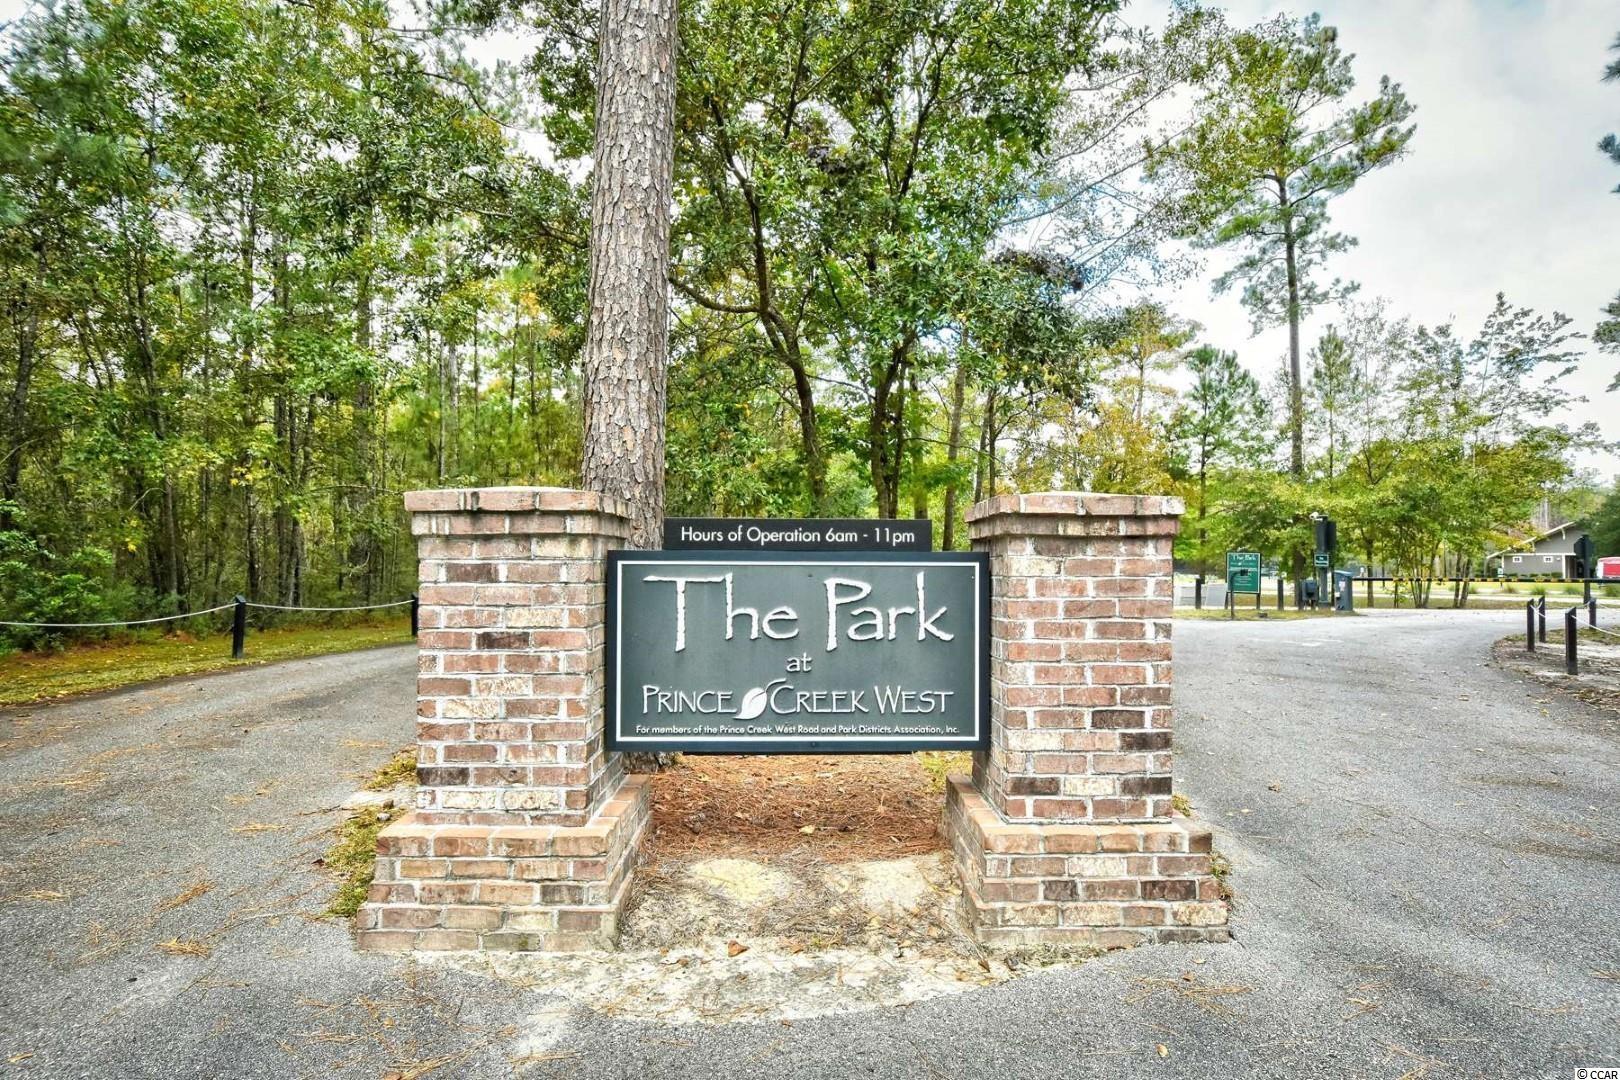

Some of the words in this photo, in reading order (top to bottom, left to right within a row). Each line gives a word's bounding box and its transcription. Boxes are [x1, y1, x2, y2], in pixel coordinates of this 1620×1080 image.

[681, 526, 724, 542] Hours
[728, 525, 743, 542] of
[746, 526, 821, 546] Operation
[825, 528, 858, 543] 6am
[874, 527, 915, 546] 11pm
[643, 572, 799, 652] The
[823, 571, 955, 652] Park
[786, 652, 812, 673] at
[641, 685, 737, 715] PRINCE
[770, 684, 869, 715] CREEK
[874, 685, 954, 714] WEST
[636, 725, 650, 734] For
[651, 724, 691, 734] members
[693, 724, 702, 734] of
[704, 725, 717, 734] the
[719, 725, 745, 734] Prince
[746, 725, 772, 734] Creek
[775, 725, 796, 734] West
[798, 725, 819, 734] Road
[821, 725, 837, 734] and
[838, 725, 857, 734] Park
[859, 725, 892, 734] Districts
[893, 725, 944, 735] Association,
[945, 725, 960, 734] Inc.
